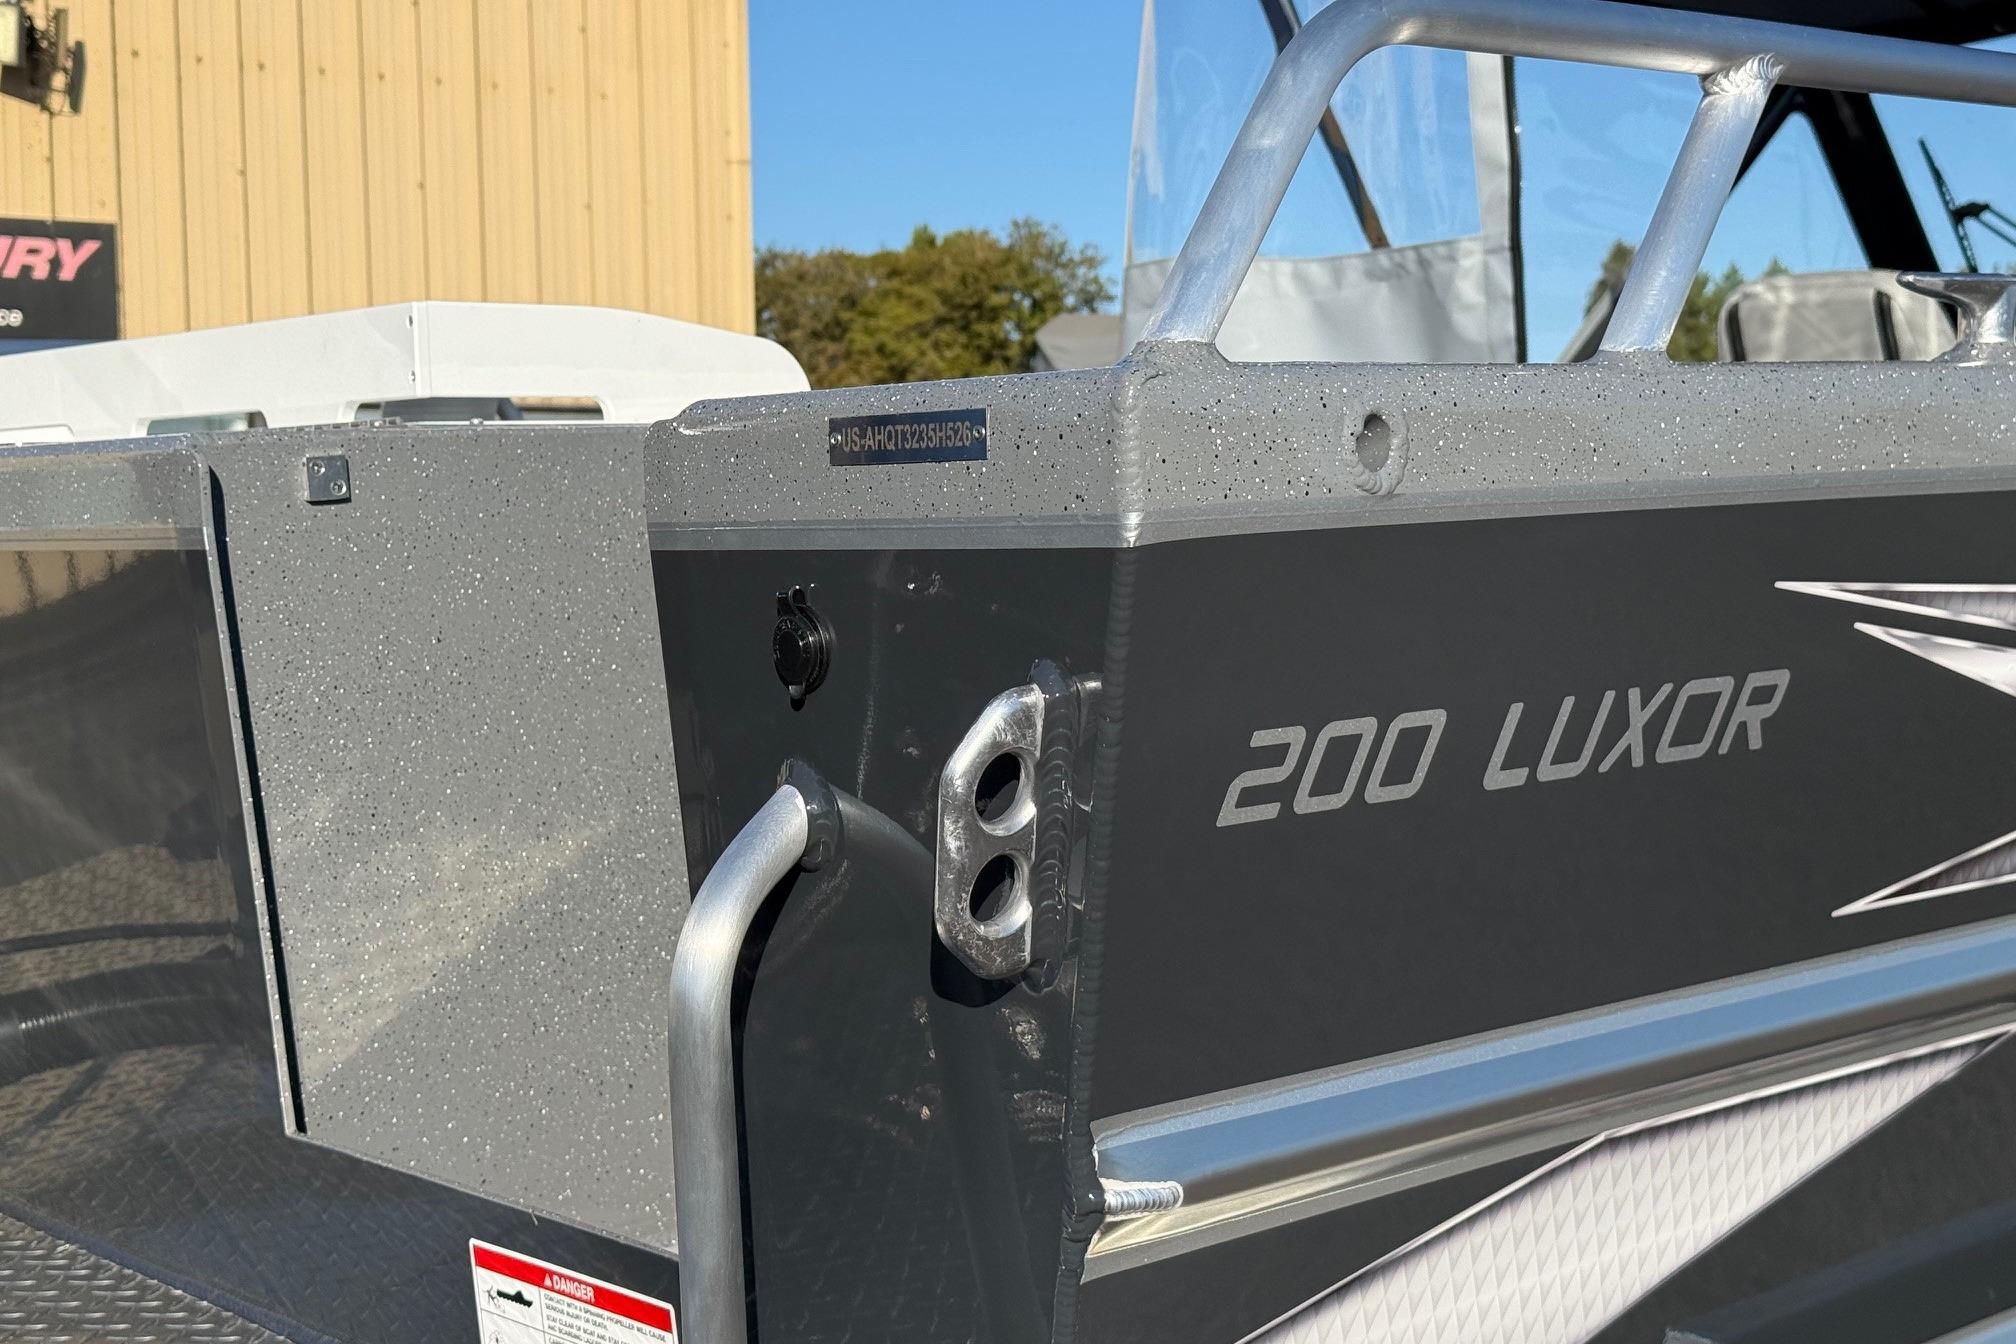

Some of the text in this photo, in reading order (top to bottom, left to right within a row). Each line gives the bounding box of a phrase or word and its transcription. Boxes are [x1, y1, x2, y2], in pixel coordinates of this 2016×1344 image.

[841, 421, 972, 453] US-AHQT3235H526
[1216, 668, 1791, 827] 200 LUXOR
[552, 1274, 596, 1304] DANGER
